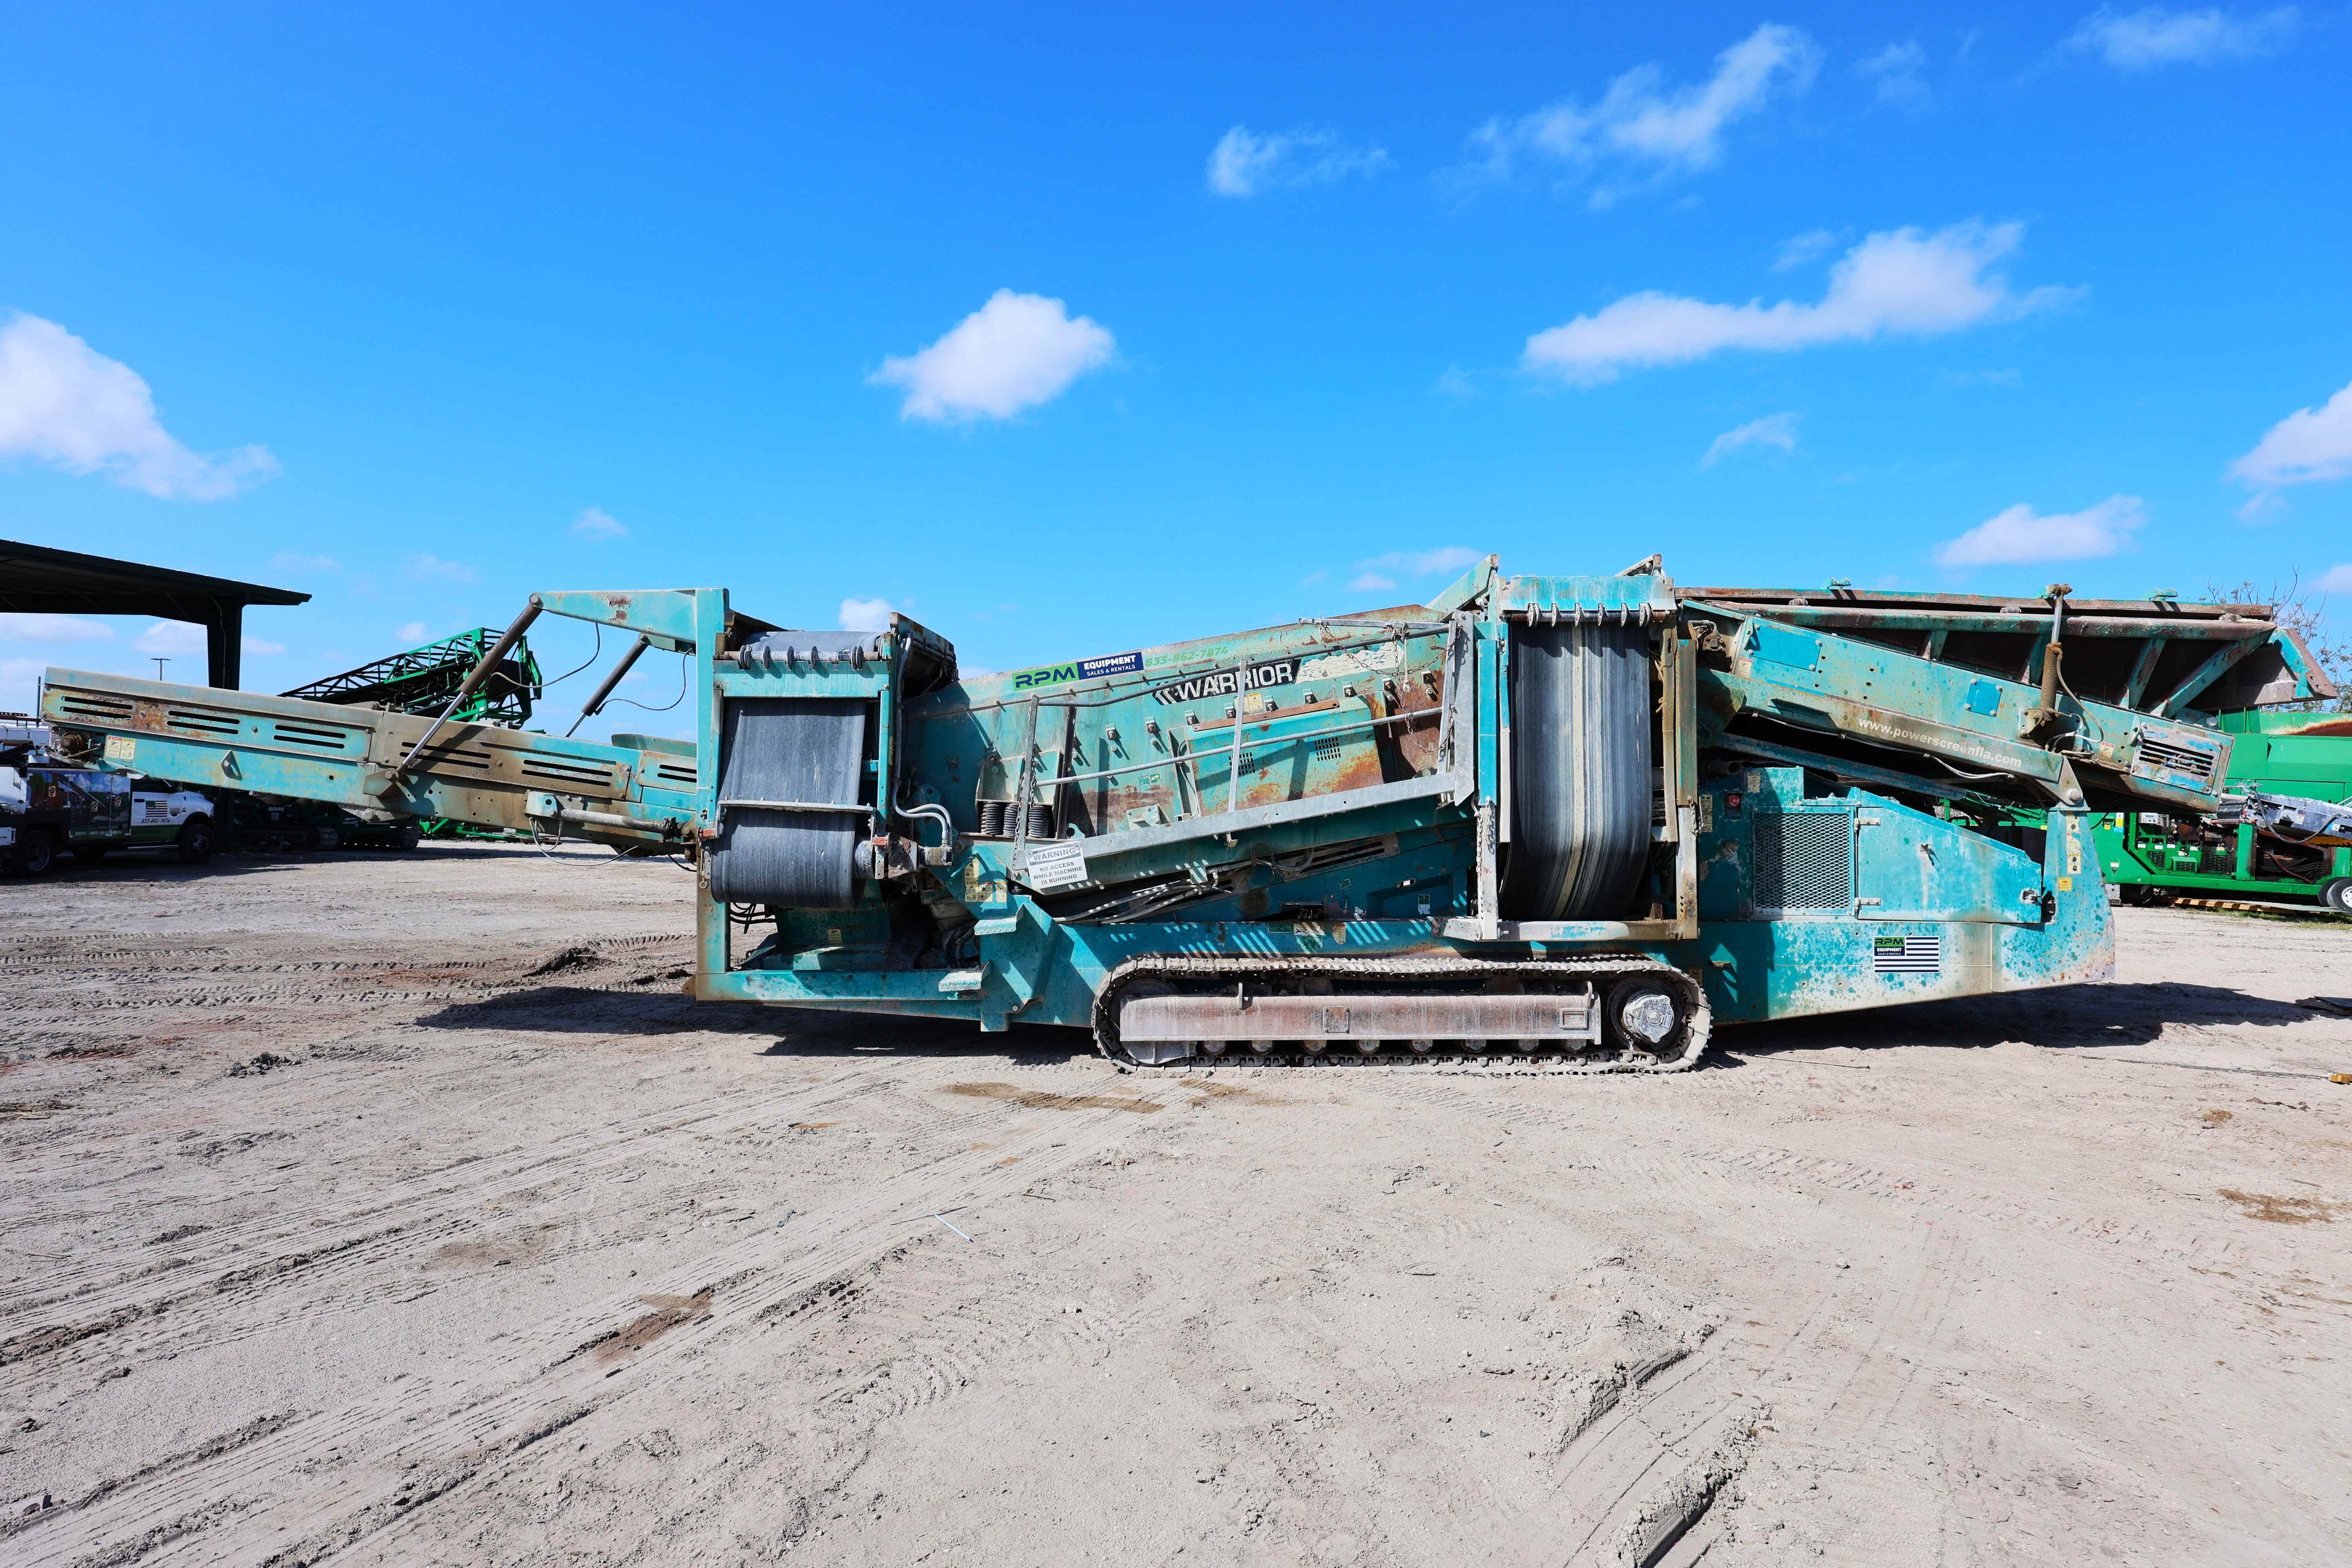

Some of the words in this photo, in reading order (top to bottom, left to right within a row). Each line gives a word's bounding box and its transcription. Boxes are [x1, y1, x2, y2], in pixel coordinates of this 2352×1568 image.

[1083, 655, 1136, 670] EQUIPMENT
[1145, 646, 1229, 667] 833-862-7874
[1111, 664, 1136, 673] RENTALS
[1015, 666, 1076, 688] RPM
[1176, 663, 1293, 700] WARRIOR
[1858, 718, 2022, 768] www.powerscreenfla.com
[1033, 848, 1075, 861] WARNING
[1050, 862, 1074, 870] ACCESS
[1054, 866, 1082, 876] MACHINE
[1049, 874, 1077, 884] RUNNING
